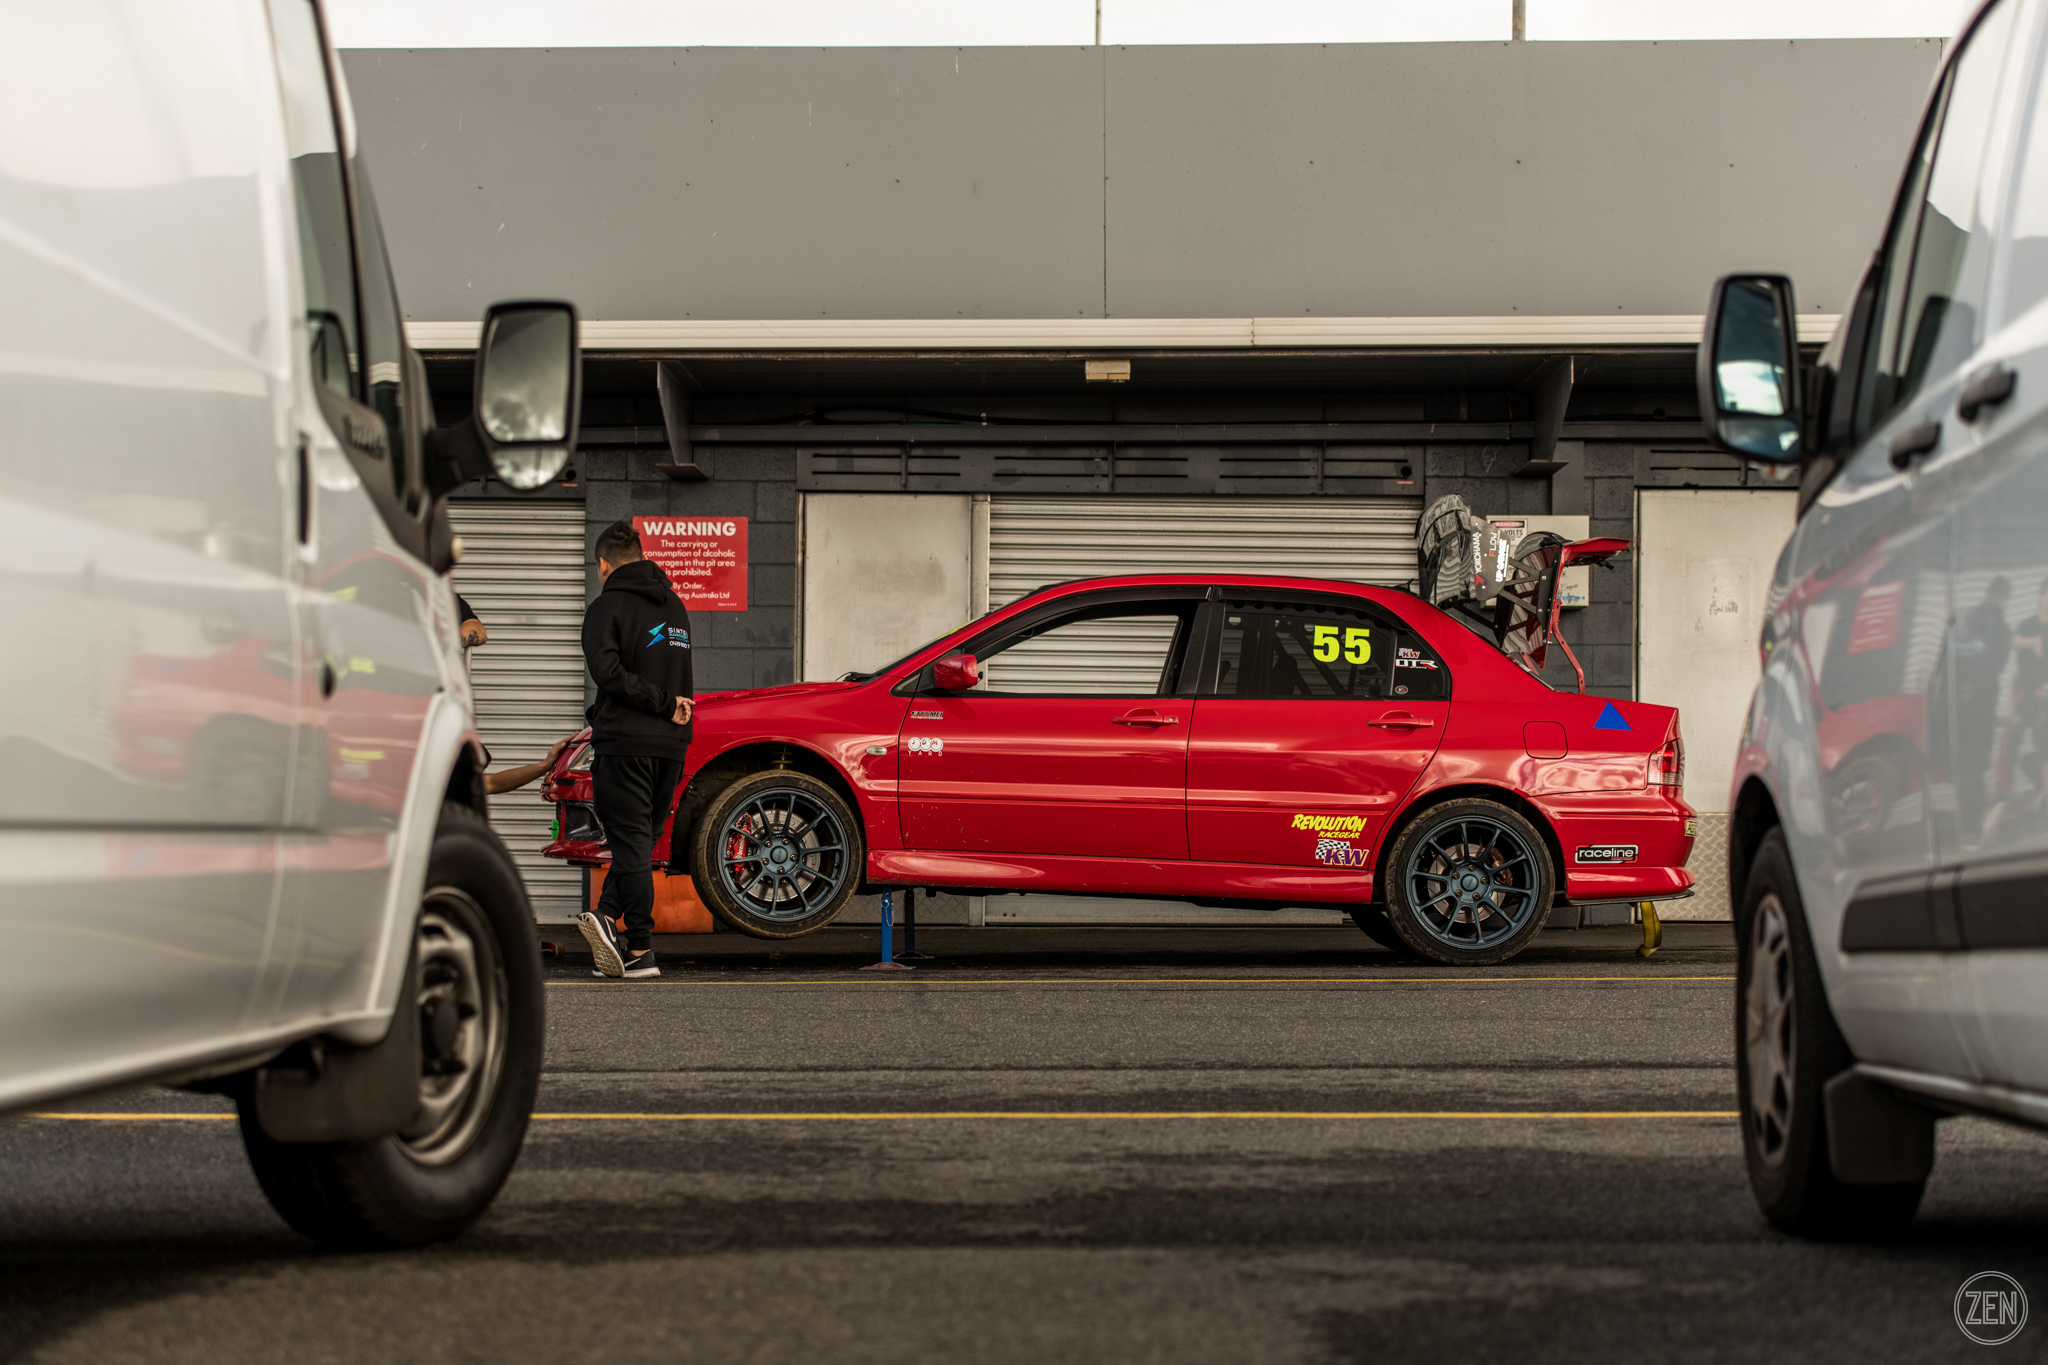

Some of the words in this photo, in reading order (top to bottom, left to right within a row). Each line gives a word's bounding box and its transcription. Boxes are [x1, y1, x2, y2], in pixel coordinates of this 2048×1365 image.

[643, 521, 737, 536] WARNING
[660, 539, 675, 548] The
[676, 540, 708, 549] carrying
[1488, 532, 1498, 557] FLOW
[643, 549, 691, 559] consumption
[694, 549, 702, 558] of
[702, 549, 736, 558] alcoholic
[1472, 532, 1482, 574] YOKOHAMA
[684, 559, 692, 567] in
[692, 559, 705, 567] the
[706, 559, 716, 569] pit
[665, 568, 671, 576] is
[672, 568, 713, 578] prohibited.
[672, 582, 681, 590] By
[682, 582, 705, 591] Order,
[1313, 625, 1371, 665] 55
[1402, 651, 1420, 659] KW
[1291, 814, 1367, 832] REVOLUTION
[1318, 831, 1360, 839] RACEGEAR
[1323, 848, 1370, 867] KW
[1579, 847, 1634, 858] raceline
